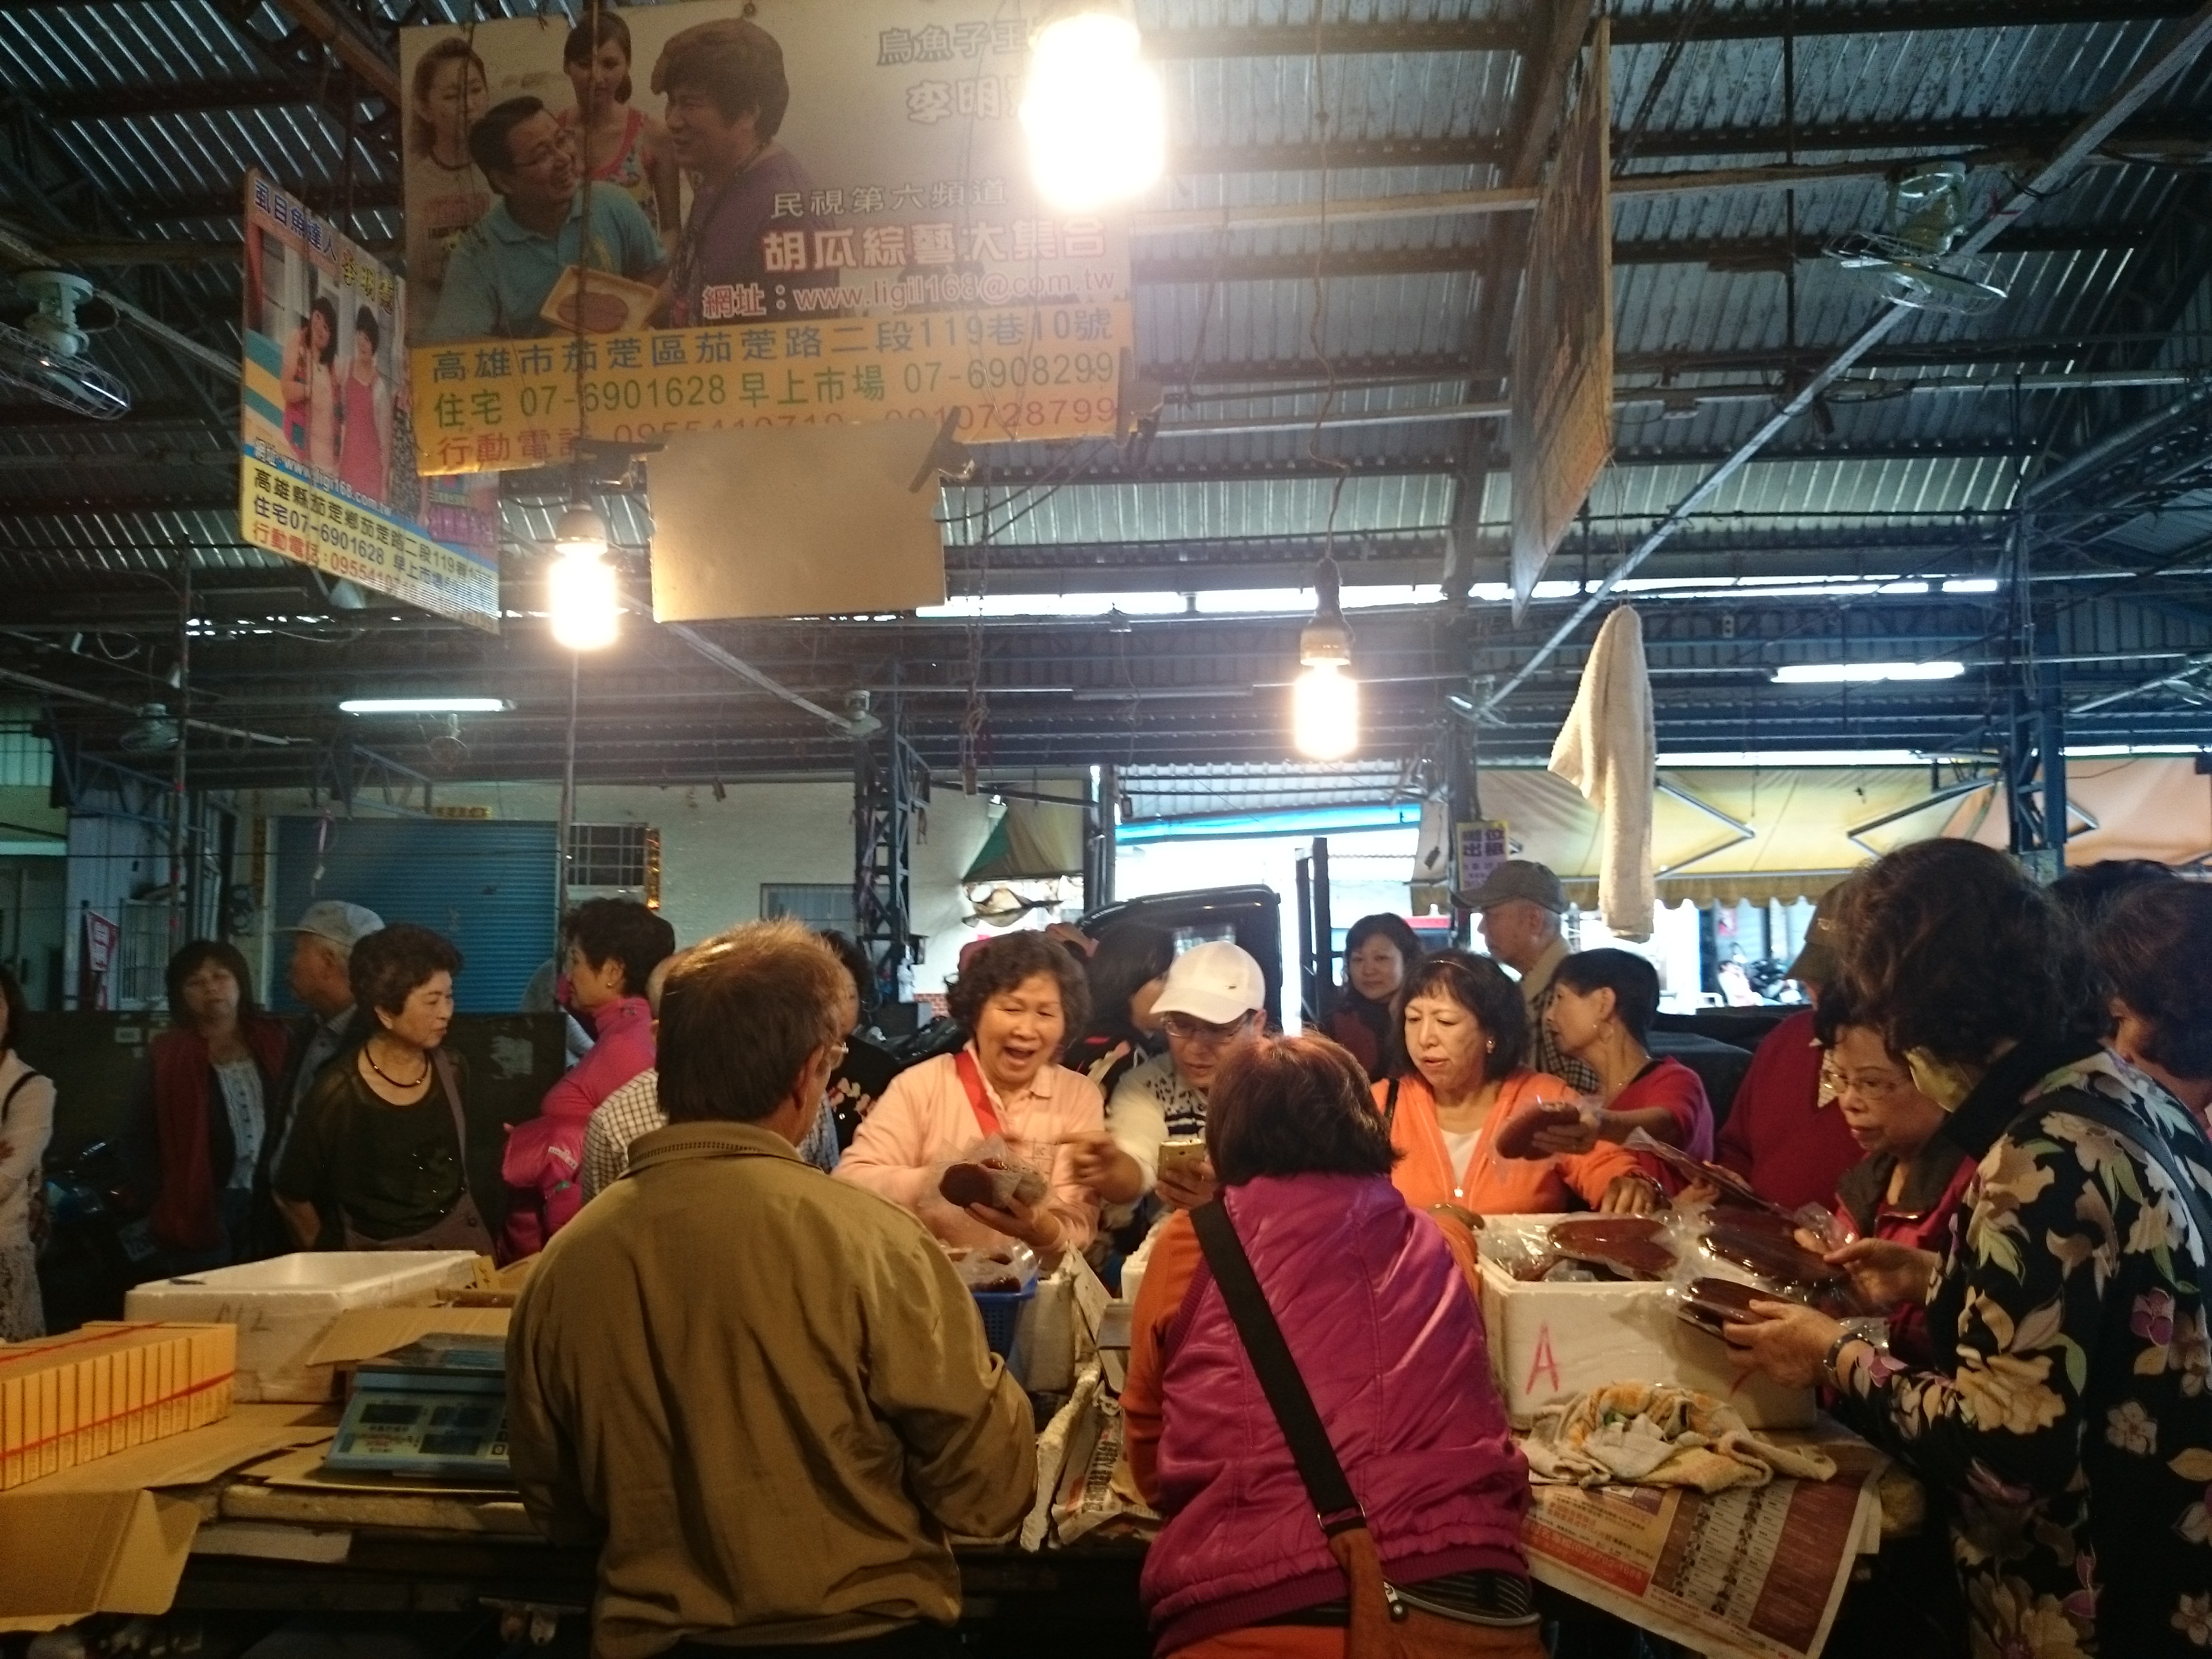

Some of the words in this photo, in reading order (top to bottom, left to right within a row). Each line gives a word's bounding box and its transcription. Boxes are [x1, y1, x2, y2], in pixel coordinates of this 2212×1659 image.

[876, 18, 1045, 66] 烏魚子王
[905, 74, 1025, 125] 李明
[771, 178, 1008, 219] 民視第六頻道
[762, 216, 1107, 272] 胡瓜綜藝大集合
[434, 388, 502, 428] 住宅
[520, 374, 726, 417] 07-6901628
[739, 363, 886, 408] 早上市場
[903, 351, 1115, 394] 07-6908299
[1525, 1321, 1560, 1395] A
